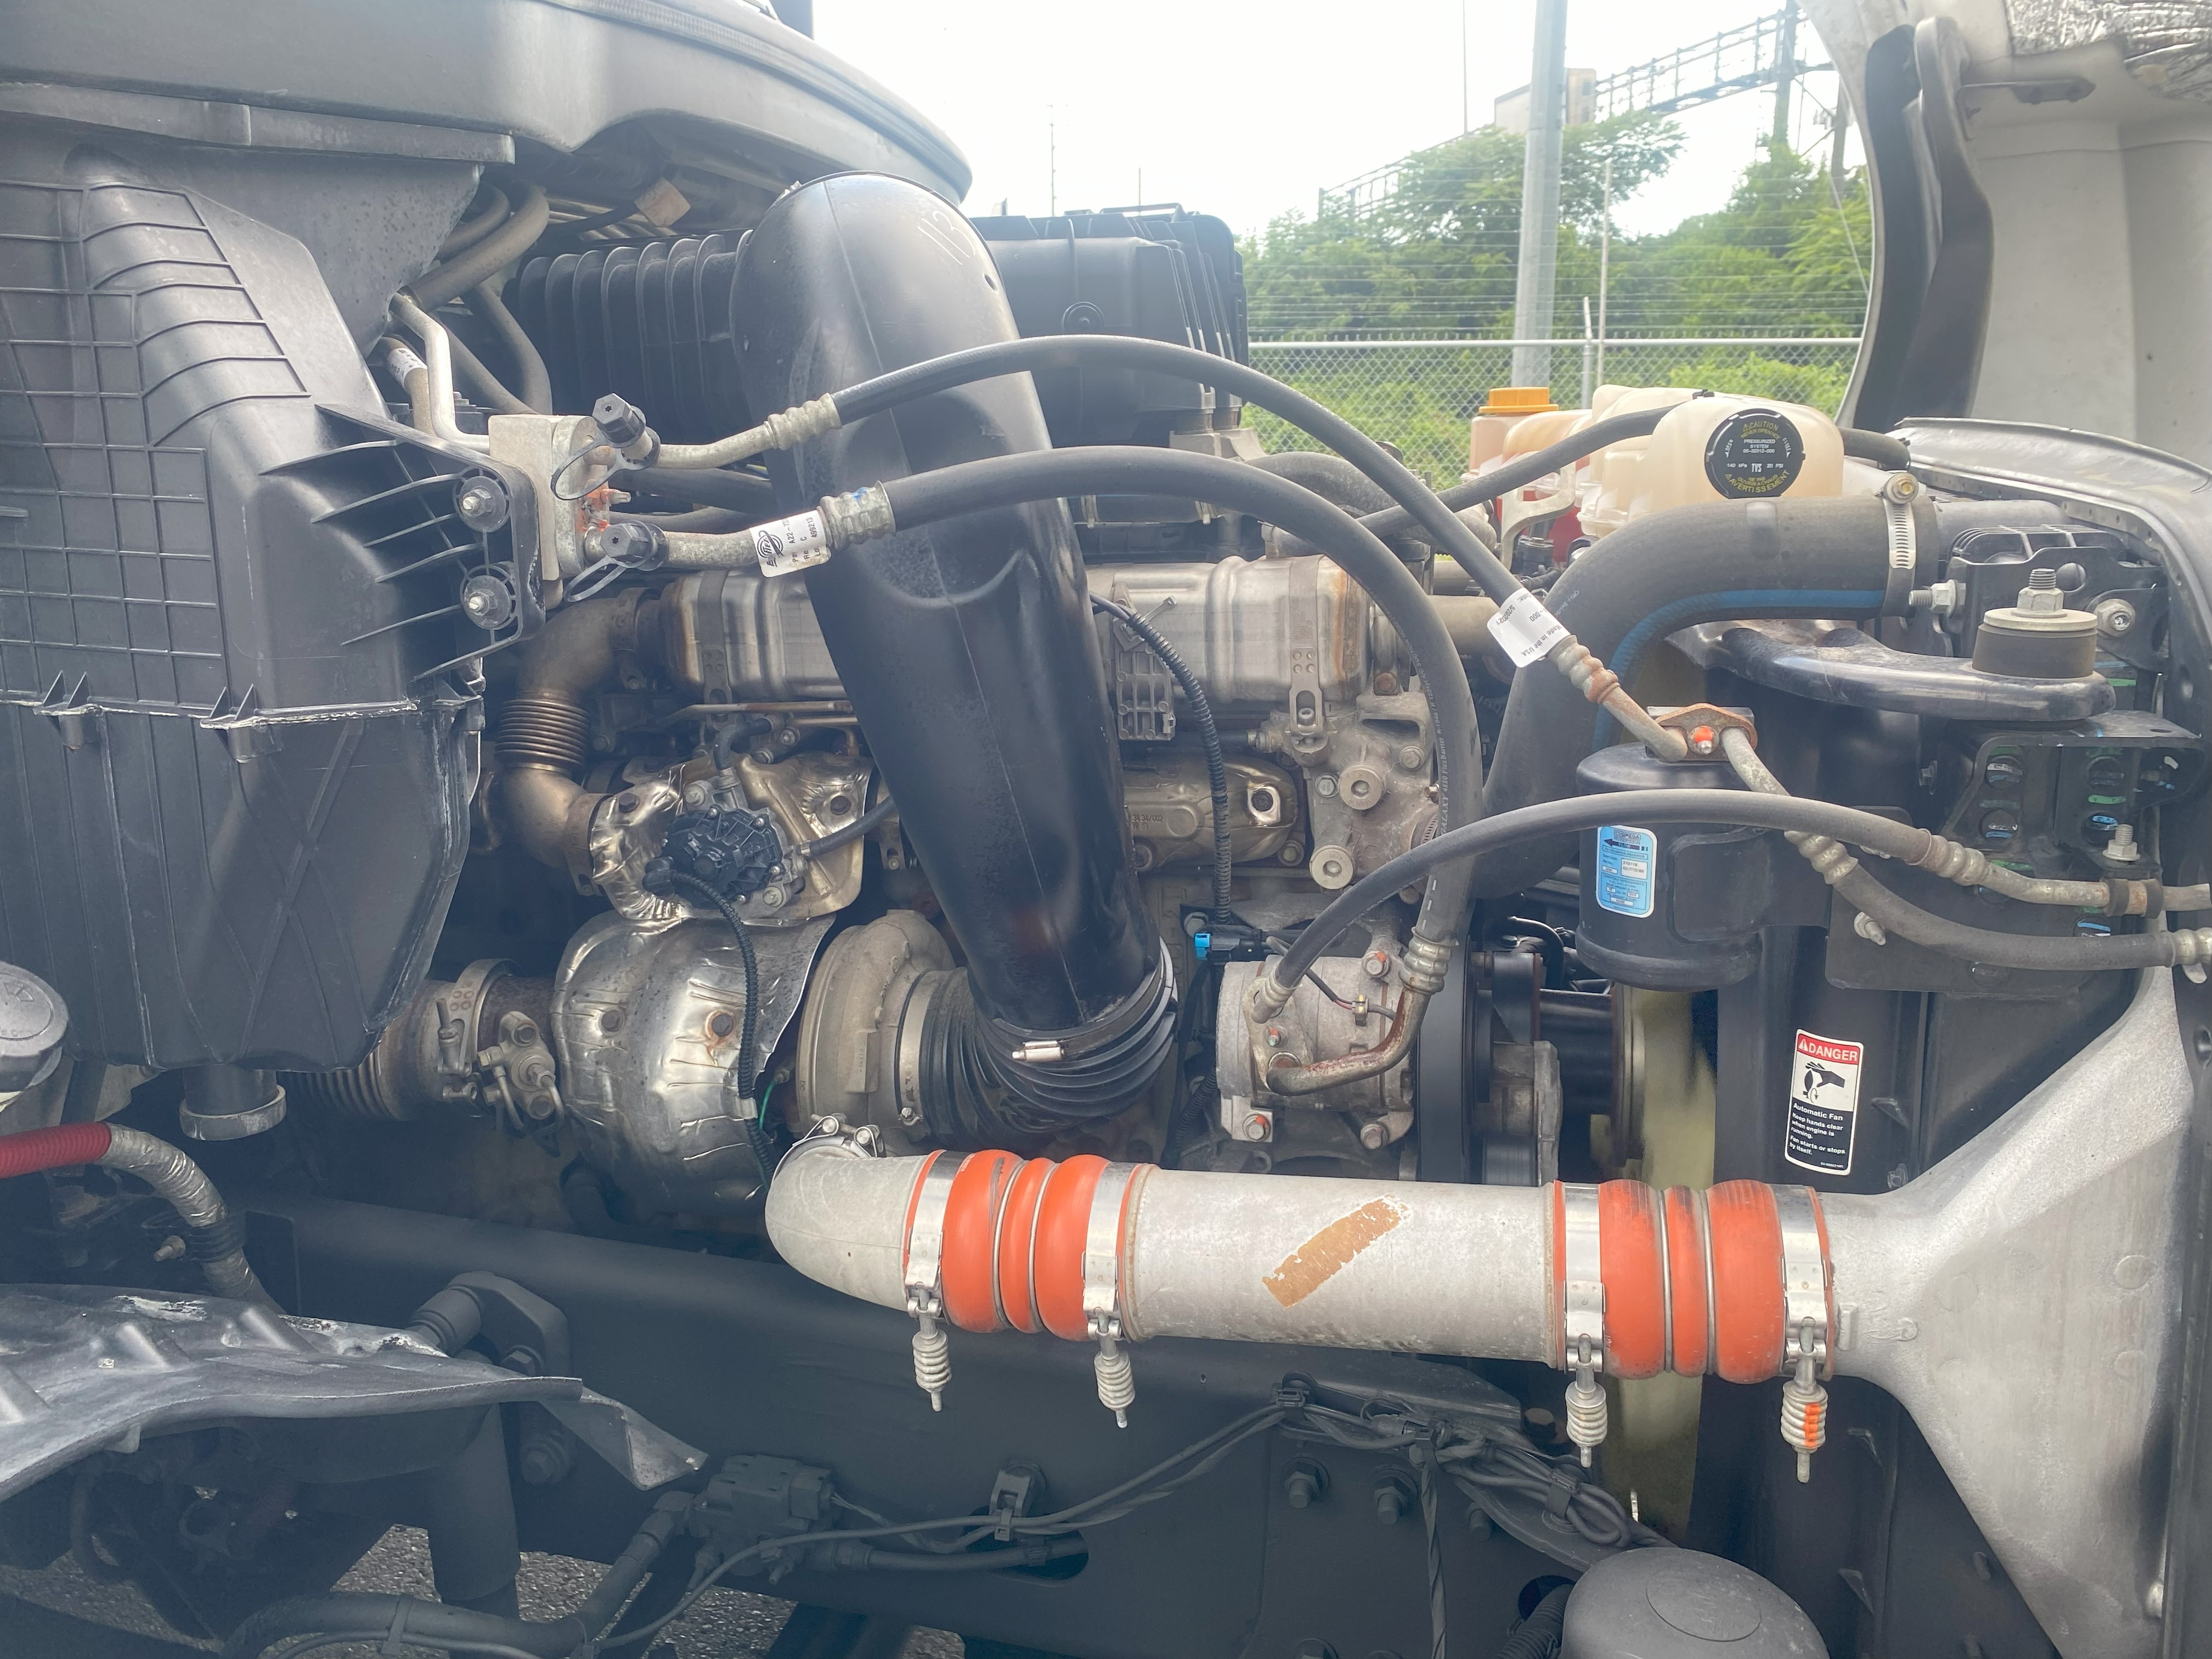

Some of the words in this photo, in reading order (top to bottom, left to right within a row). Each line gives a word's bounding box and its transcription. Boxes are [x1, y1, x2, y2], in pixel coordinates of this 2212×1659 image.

[1750, 421, 1779, 431] CAUTION
[1741, 429, 1757, 438] NEVER
[1751, 463, 1762, 472] TVS
[806, 517, 817, 538] 499213
[1547, 624, 1562, 636] Made
[1533, 640, 1543, 648] the
[1405, 639, 1422, 667] SUCTION
[1521, 647, 1534, 656] USA
[1809, 1042, 1858, 1062] DANGER
[1793, 1103, 1827, 1119] Automatic
[1792, 1112, 1805, 1122] Keep
[1807, 1118, 1825, 1127] hands
[1791, 1126, 1813, 1139] running.
[1792, 1120, 1805, 1129] when
[1806, 1125, 1827, 1135] engine
[1790, 1135, 1799, 1143] Fan
[1800, 1141, 1818, 1149] starts
[1796, 1145, 1813, 1155] itself.
